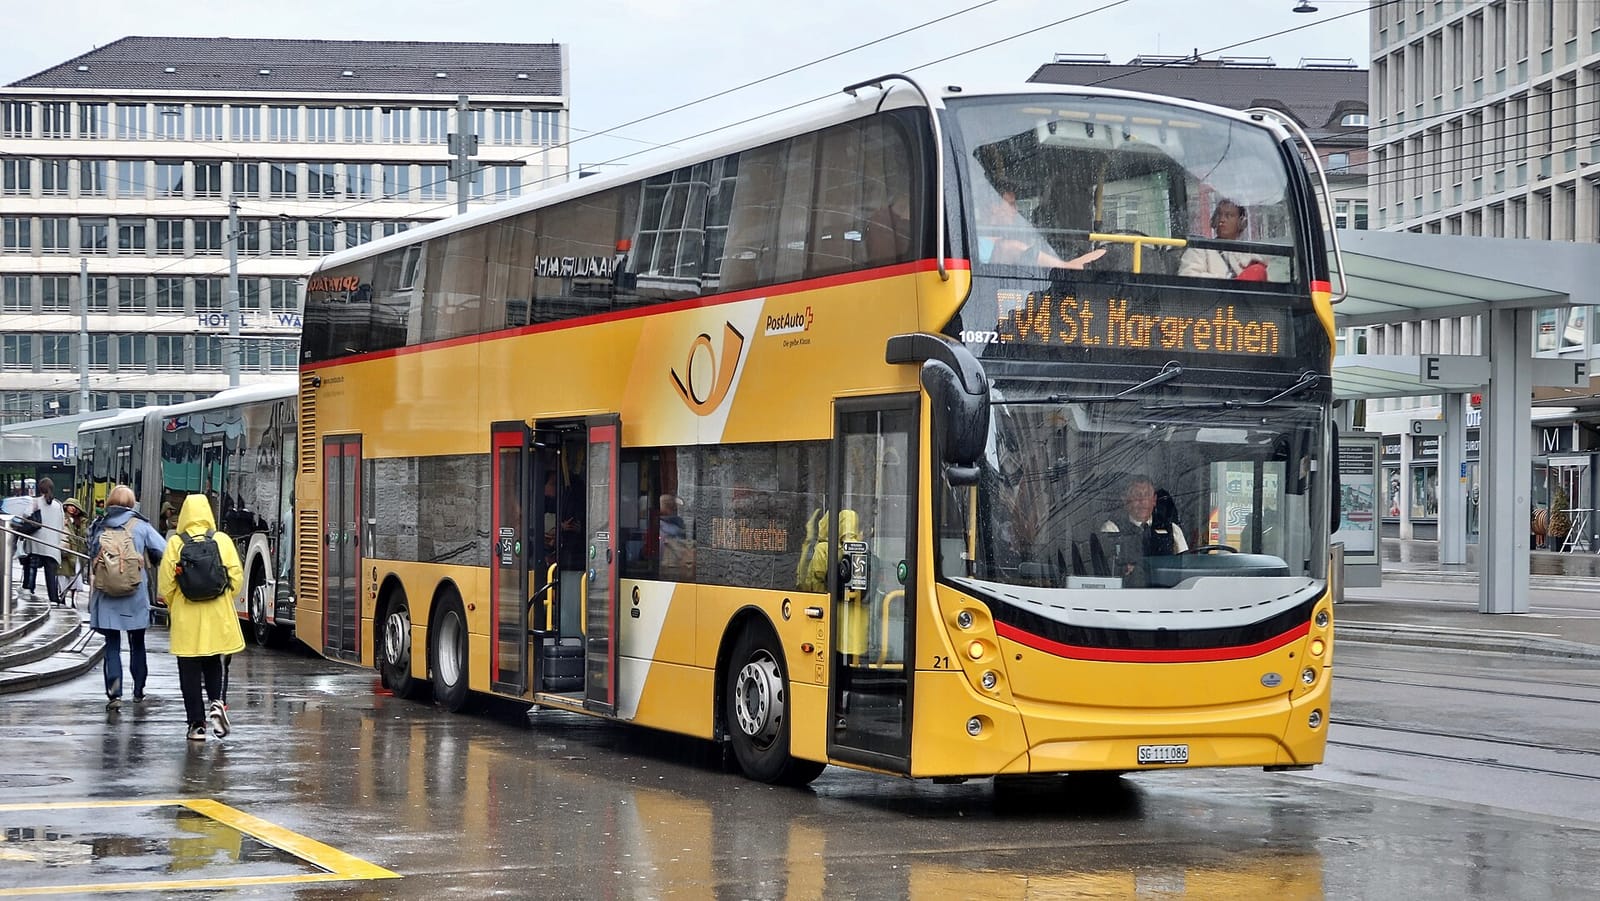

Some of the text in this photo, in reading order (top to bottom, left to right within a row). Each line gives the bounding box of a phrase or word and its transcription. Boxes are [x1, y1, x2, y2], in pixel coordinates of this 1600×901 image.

[198, 314, 248, 327] HOTL
[766, 312, 805, 331] PostAuto
[1060, 296, 1101, 344] St.
[1107, 299, 1280, 353] Margrethen
[959, 330, 999, 344] 10872
[1426, 358, 1440, 380] E
[1574, 363, 1586, 385] F
[1413, 421, 1423, 434] G
[1543, 428, 1559, 451] M
[933, 655, 949, 669] 21
[1140, 748, 1151, 760] SG
